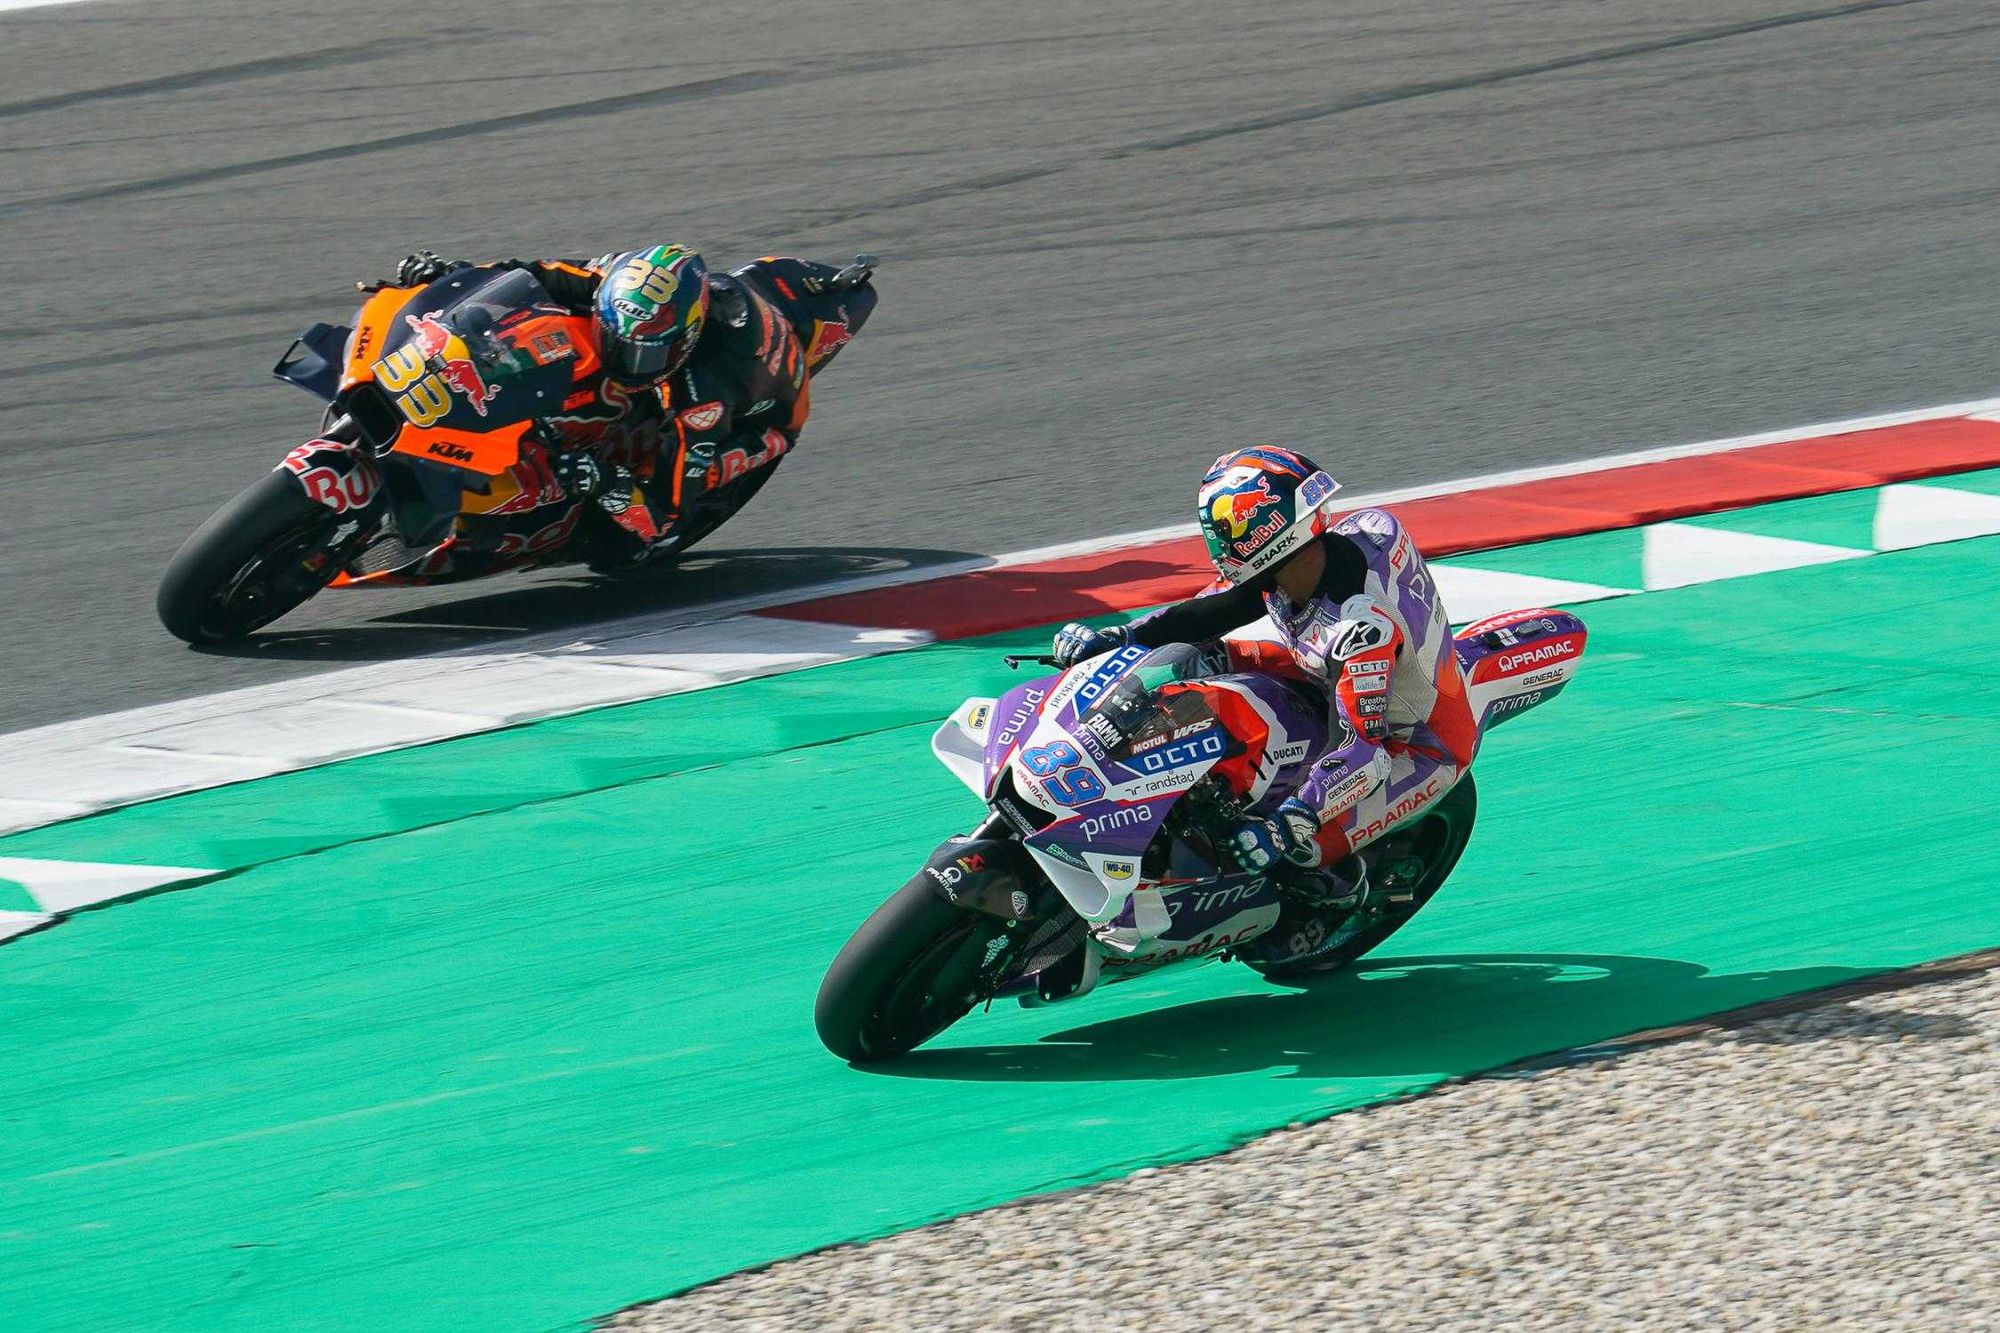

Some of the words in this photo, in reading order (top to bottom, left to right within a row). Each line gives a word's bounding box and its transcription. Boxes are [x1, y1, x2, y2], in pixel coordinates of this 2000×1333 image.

[614, 258, 680, 305] 33
[369, 342, 453, 428] 33
[427, 441, 474, 462] KTM
[1301, 471, 1336, 507] 89
[1234, 530, 1264, 557] Red
[1254, 510, 1287, 541] Bull
[1252, 529, 1298, 570] SHARK
[1081, 645, 1143, 699] OCTO
[1349, 661, 1388, 674] OCTO
[1512, 640, 1574, 668] PRAMAC
[1522, 668, 1564, 685] GENERAC
[998, 688, 1045, 745] prima
[1492, 691, 1541, 714] prima
[1073, 722, 1105, 760] prima
[1133, 735, 1167, 754] MOTUL
[1173, 717, 1215, 740] WRS
[1143, 735, 1221, 771] OCTO
[1273, 746, 1304, 761] DUCATI
[1016, 769, 1050, 808] PRAMAC
[1020, 740, 1106, 807] 89
[1145, 770, 1194, 792] randstad
[1321, 765, 1348, 790] prima
[1328, 771, 1366, 800] GENERAC
[1322, 784, 1369, 820] PRAMAC
[1350, 779, 1441, 847] PRAMAC
[1079, 804, 1152, 842] prima
[926, 866, 960, 902] PRAMAC
[1105, 862, 1131, 873] WD-40
